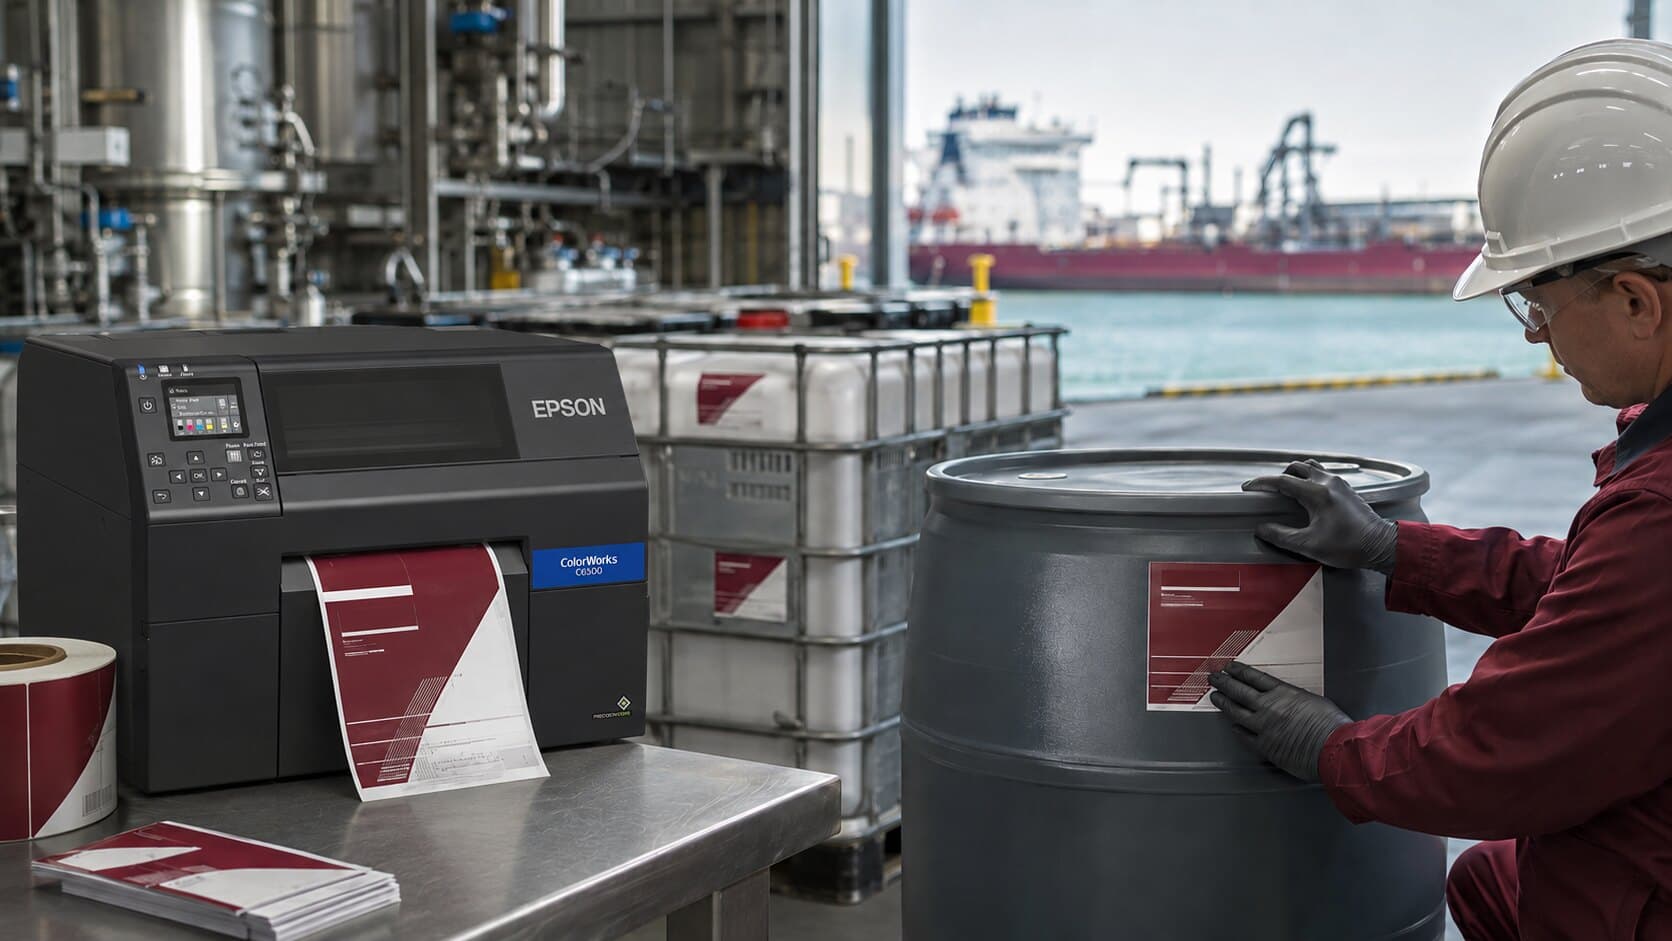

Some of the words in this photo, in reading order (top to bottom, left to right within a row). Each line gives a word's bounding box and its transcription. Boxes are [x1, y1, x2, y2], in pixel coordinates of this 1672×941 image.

[531, 398, 606, 418] EPSON
[560, 555, 618, 568] ColorWorks
[575, 567, 603, 577] C6500
